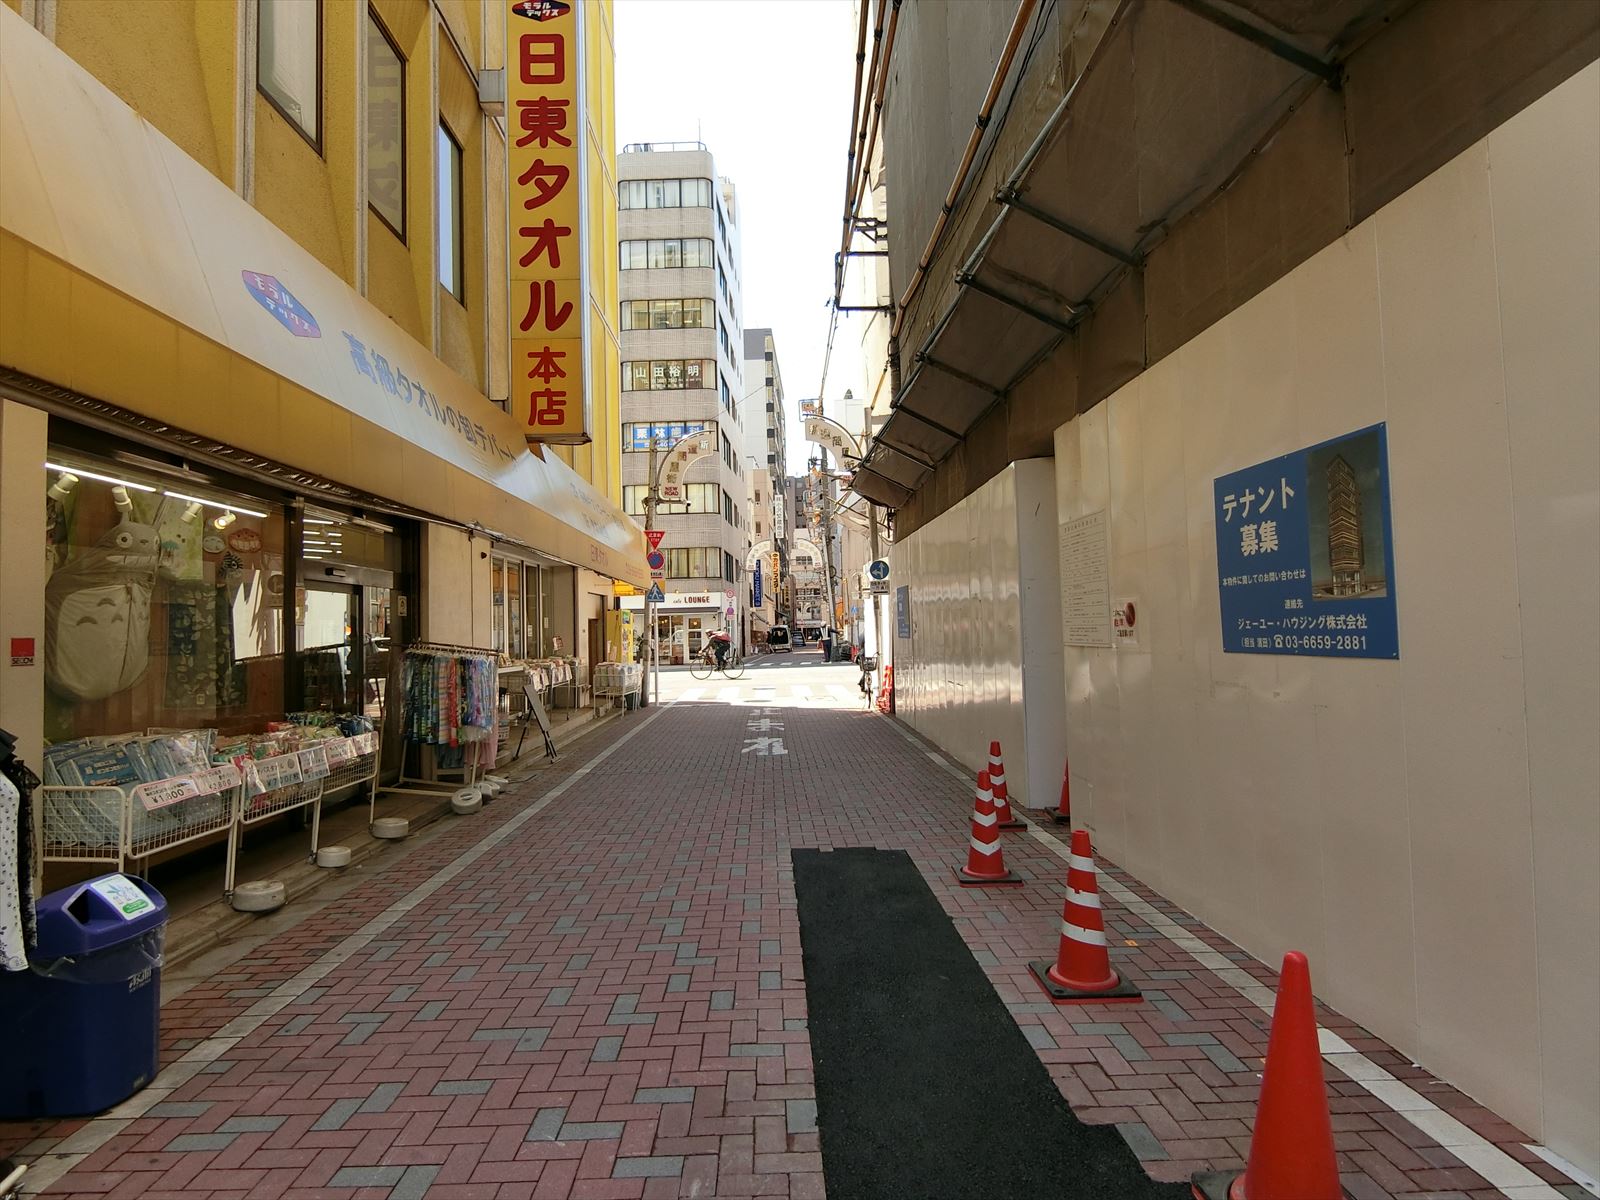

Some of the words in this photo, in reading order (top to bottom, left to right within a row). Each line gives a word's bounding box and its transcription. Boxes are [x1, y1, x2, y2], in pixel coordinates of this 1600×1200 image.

[522, 2, 552, 10] モラル
[527, 9, 560, 17] テックス
[254, 273, 294, 309] モラル
[265, 299, 312, 334] テックス
[635, 365, 699, 378] 山田裕明
[1223, 477, 1295, 523] テナント
[1240, 520, 1279, 556] 募集
[1222, 569, 1306, 586] 本物件に関してのお問い合わせは
[684, 596, 710, 604] LOUNGE
[1237, 614, 1367, 630] ジェーユー・ハウジング株式会社
[1285, 635, 1366, 650] 03-6659-2881
